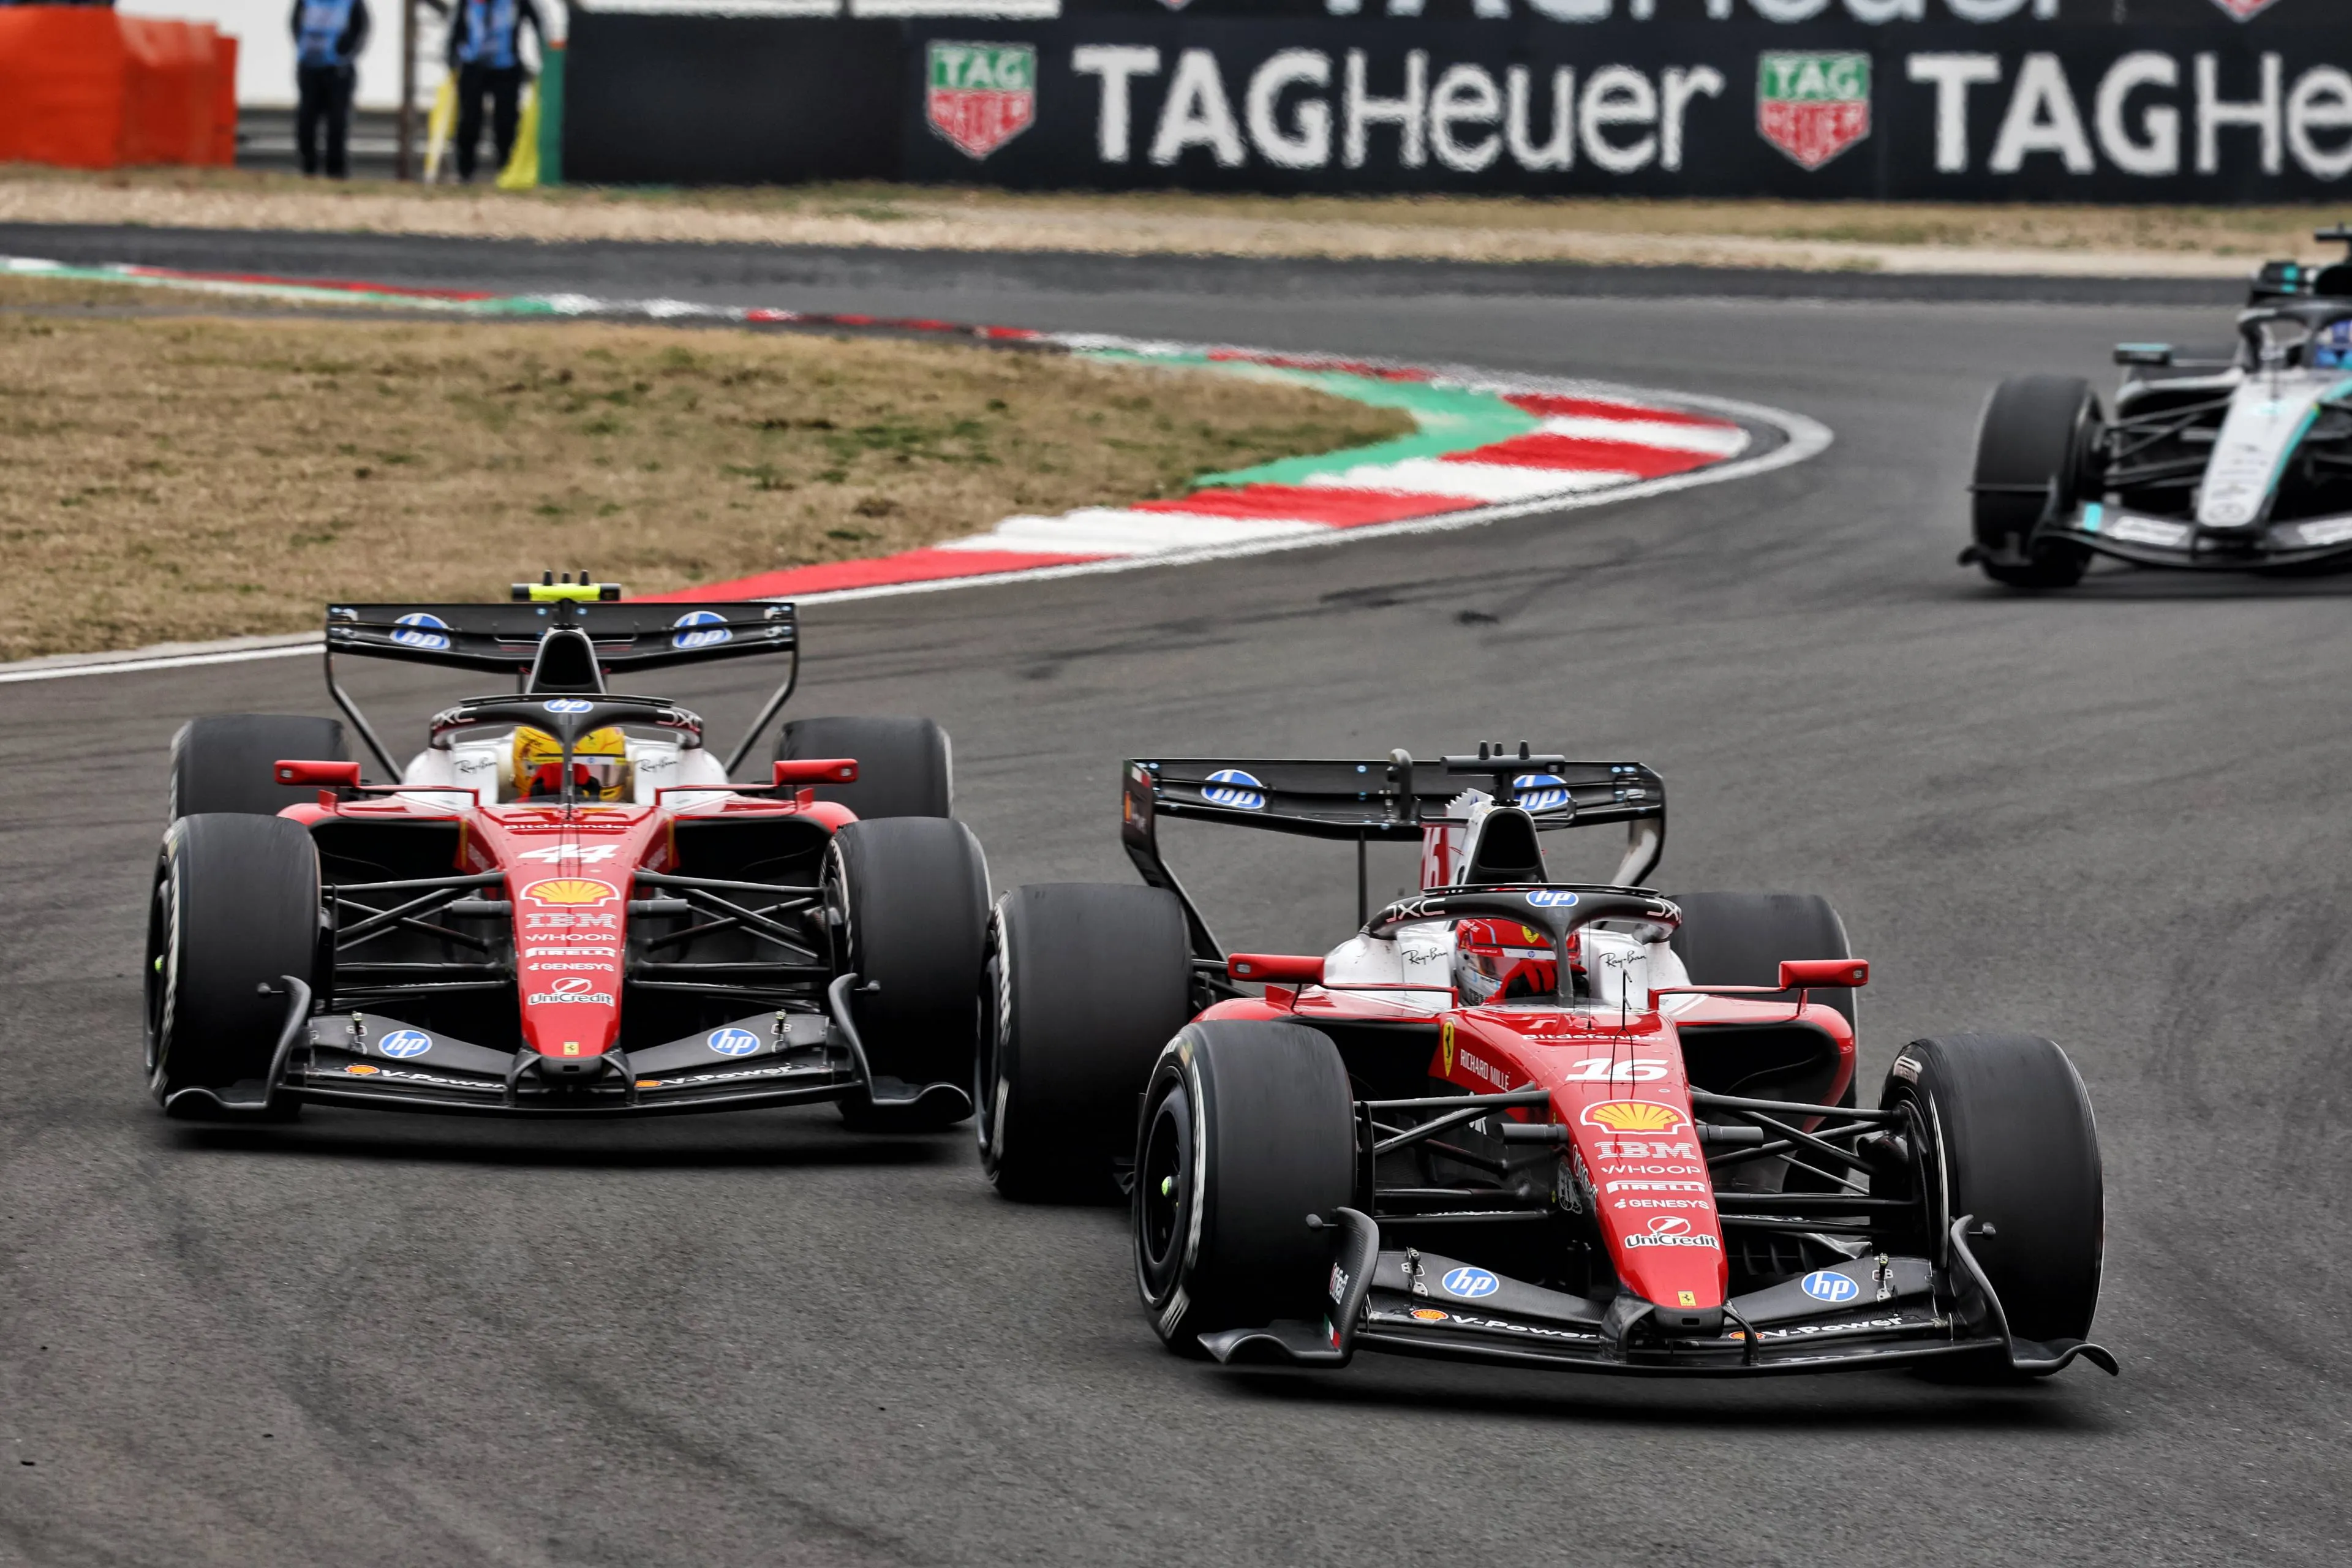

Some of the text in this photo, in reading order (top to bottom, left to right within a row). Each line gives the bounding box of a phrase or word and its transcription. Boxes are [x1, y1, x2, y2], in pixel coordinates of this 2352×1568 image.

[941, 50, 1025, 89] TAG
[1772, 58, 1860, 99] TAG
[517, 844, 620, 863] 44
[1534, 891, 1572, 907] hp
[525, 913, 617, 929] IBM
[525, 947, 616, 958] PIRELLI
[1401, 948, 1449, 965] Ray-Ban
[1599, 951, 1646, 968] Ray-Ban
[541, 963, 614, 971] GENESYS
[529, 993, 614, 1005] UniCredit
[385, 1030, 428, 1058] hp
[715, 1028, 753, 1055] hp
[382, 1069, 508, 1088] V-Power
[662, 1065, 793, 1084] V-Power
[1460, 1049, 1510, 1092] RICHARD MILLE
[1566, 1058, 1668, 1081] 16
[1594, 1141, 1697, 1160] IBM
[1601, 1166, 1701, 1175] WHOOP
[1605, 1180, 1706, 1194] PIRELLI
[1629, 1199, 1709, 1209] GENESYS
[1626, 1234, 1718, 1248] UniCredit
[1449, 1267, 1493, 1297] hp
[1812, 1272, 1850, 1302] hp
[1452, 1314, 1597, 1340] V-Power
[1764, 1316, 1904, 1338] V-Power
